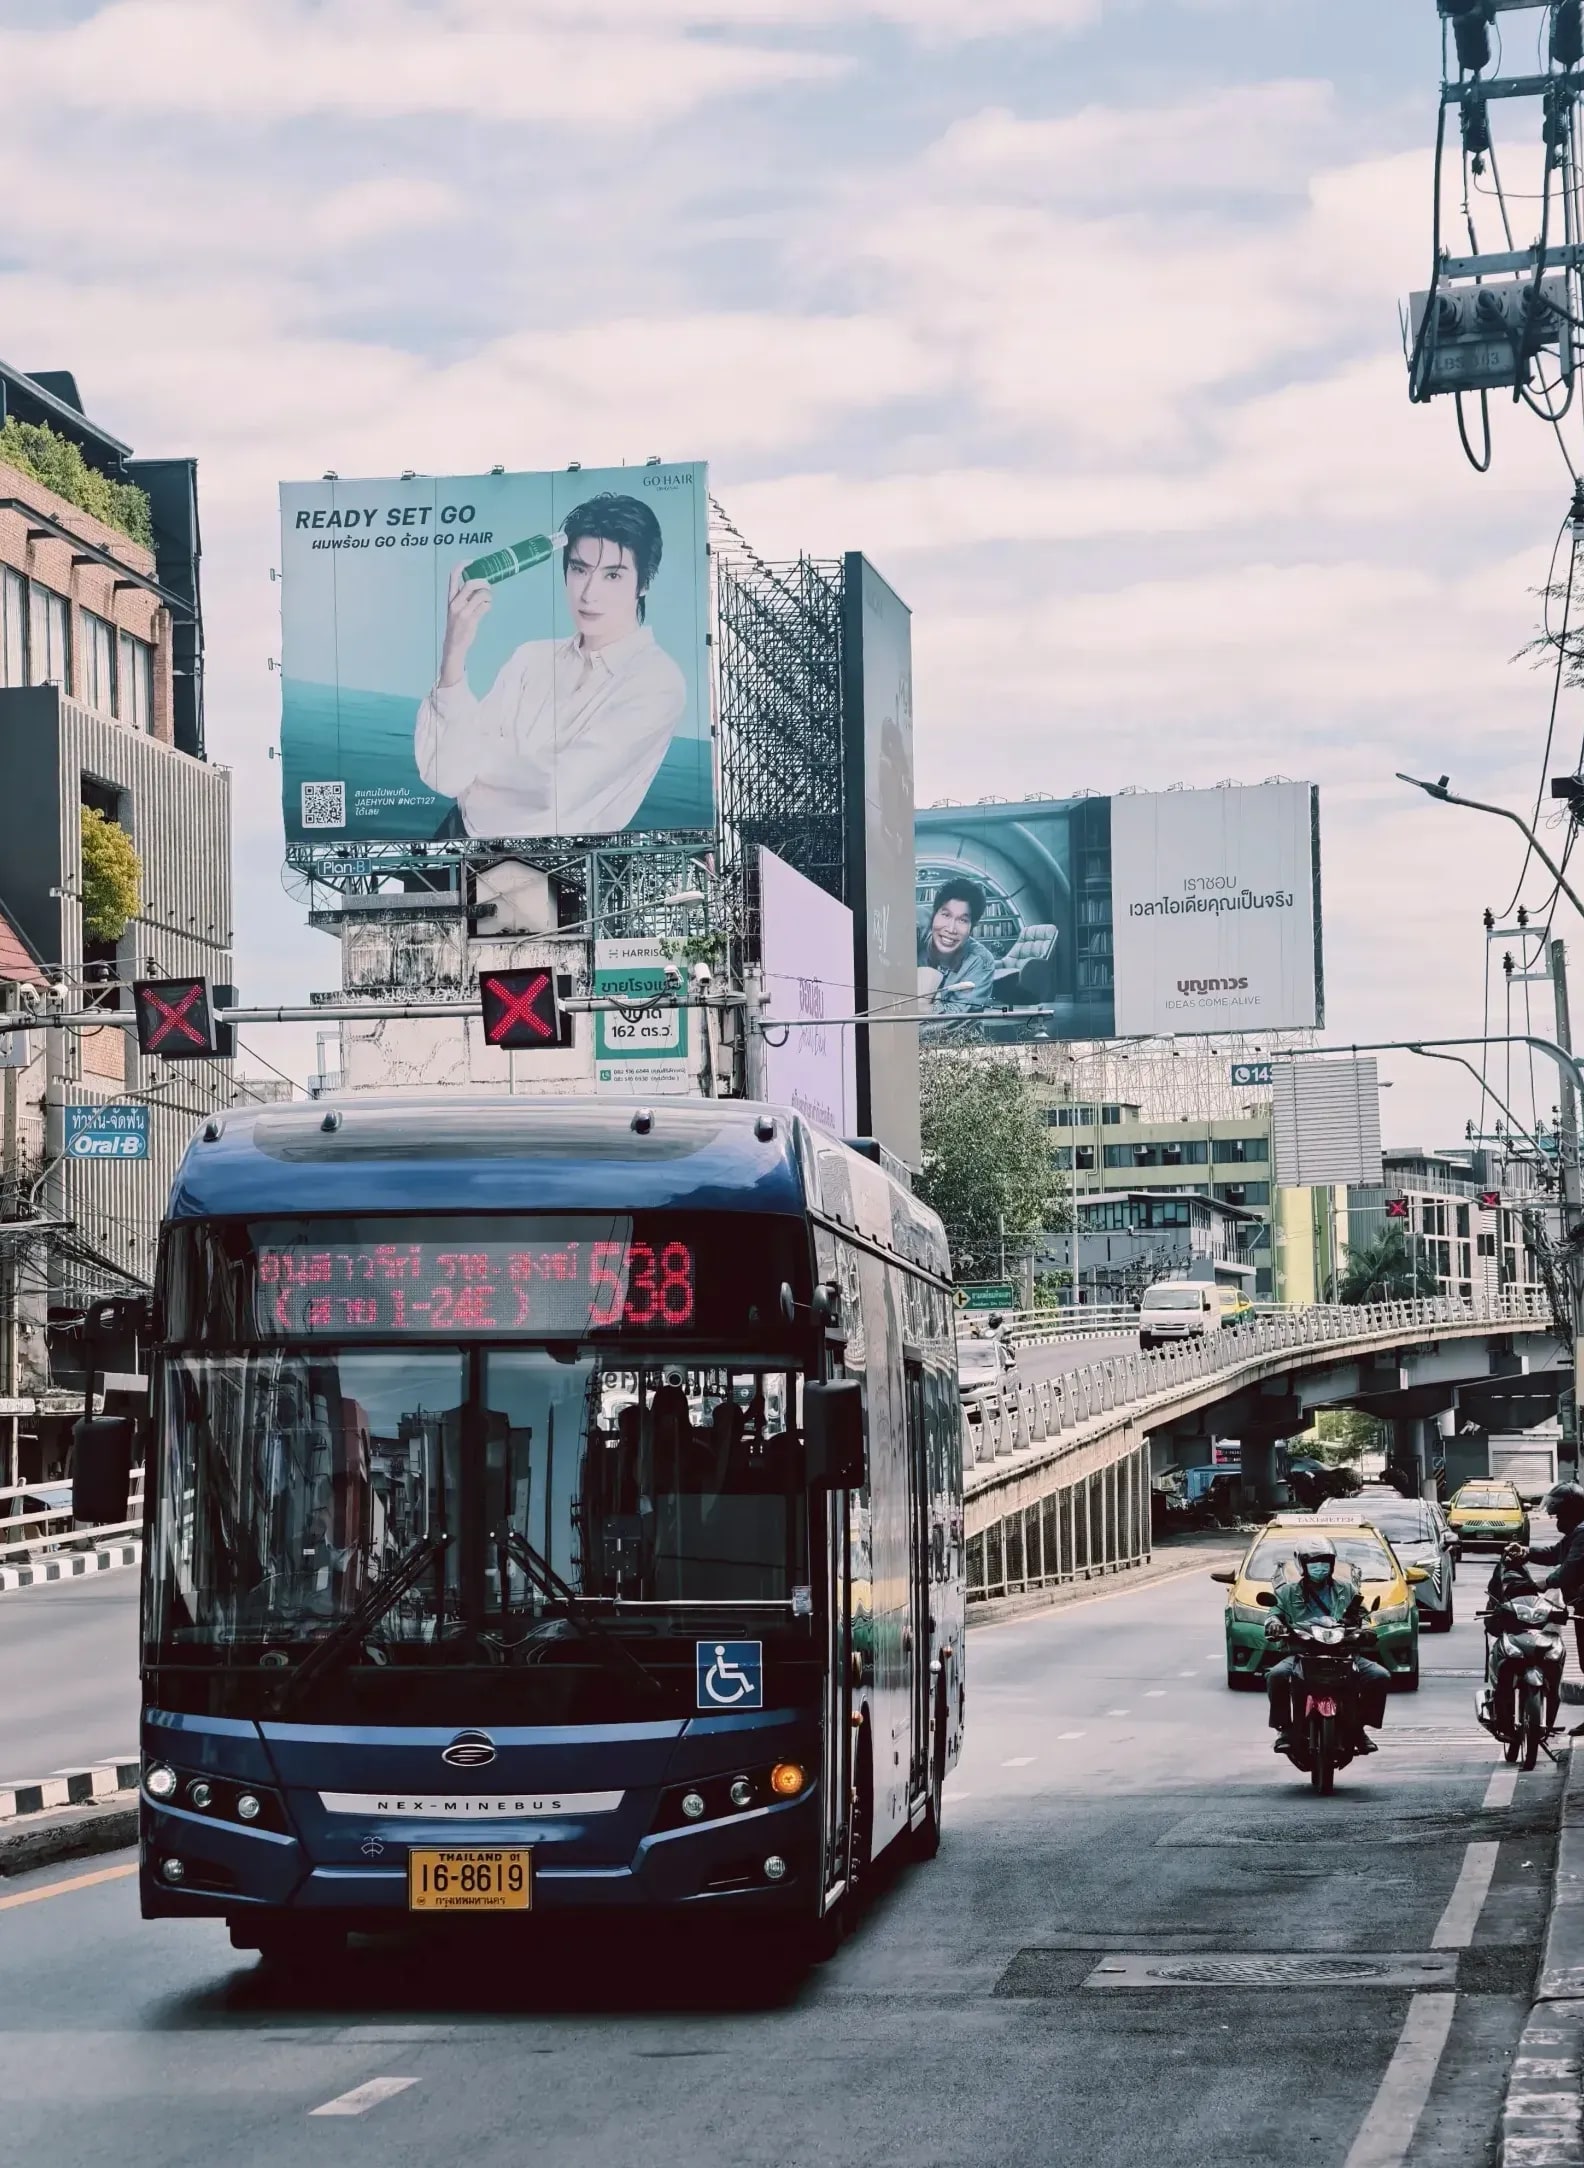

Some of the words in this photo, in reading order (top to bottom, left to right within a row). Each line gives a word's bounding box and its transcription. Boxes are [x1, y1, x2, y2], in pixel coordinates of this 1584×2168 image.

[643, 476, 661, 487] GO
[663, 474, 692, 485] HAIR
[295, 508, 378, 529] READY
[386, 506, 432, 527] SET
[440, 504, 476, 524] GO
[312, 535, 370, 549] ผมพร้อม
[375, 535, 396, 548] GO
[400, 532, 428, 546] ด้วย
[433, 533, 455, 546] GO
[458, 531, 493, 544] HAIR
[354, 798, 395, 806] JAEHYUN
[397, 797, 436, 806] #NCT127
[1183, 875, 1237, 891] เราชอบ
[1129, 889, 1294, 917] เวลาไอเดียคุณเป็นจริง
[622, 948, 674, 957] HARRISO
[1177, 976, 1249, 996] บุญถาวร
[1165, 999, 1196, 1009] IDEAS
[1198, 997, 1229, 1008] COME
[1231, 996, 1261, 1006] ALIVE
[611, 1025, 636, 1037] 162
[1251, 1066, 1273, 1081] 14
[75, 1135, 140, 1154] Oral-B
[588, 1241, 694, 1325] 538
[390, 1286, 496, 1328] 1-24E
[377, 1800, 562, 1811] NEX-MINEBUS
[438, 1853, 502, 1861] THAILAND
[422, 1864, 523, 1892] 16-8619
[435, 1896, 506, 1907] กรุงเทพมหานคร
